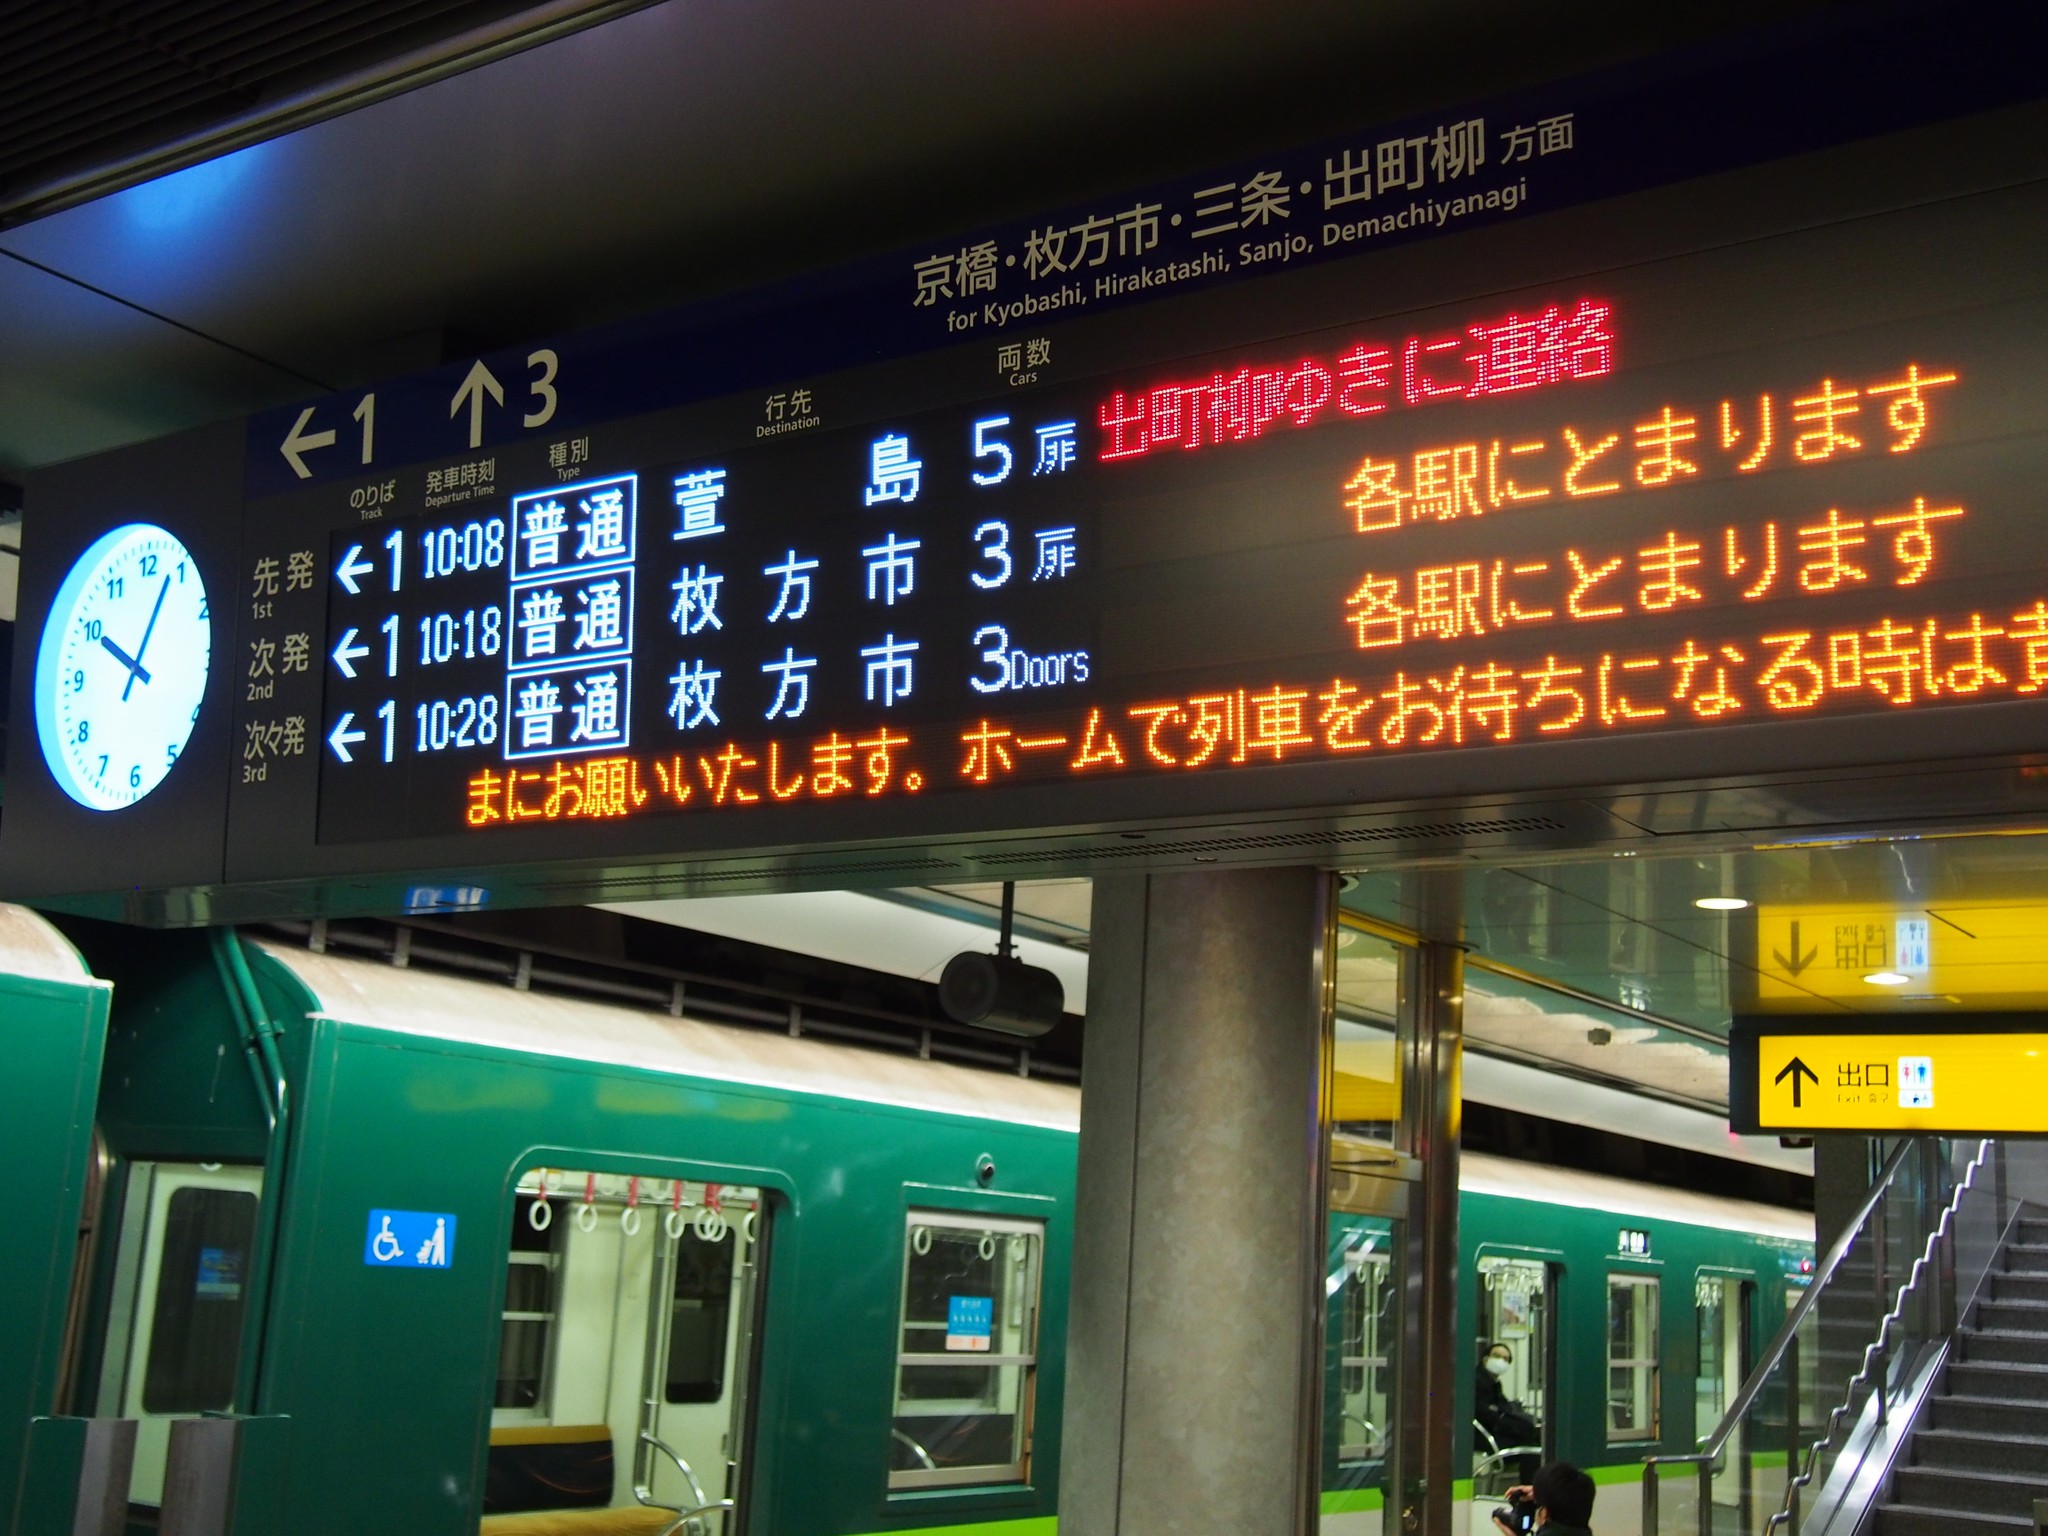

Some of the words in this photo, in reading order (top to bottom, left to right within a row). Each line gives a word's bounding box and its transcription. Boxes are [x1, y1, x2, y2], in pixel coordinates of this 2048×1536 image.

[1501, 113, 1574, 165] 方面
[947, 309, 977, 332] for
[984, 282, 1087, 326] Kyobashi,
[1095, 248, 1231, 298] Hirakatashi,
[1239, 233, 1314, 266] Sanjo,
[1323, 177, 1527, 246] Demachiyanagi
[997, 337, 1052, 374] 両数
[524, 349, 558, 428] 3
[1009, 371, 1038, 387] Cars
[1101, 301, 1615, 459] 出町柳ゆきに連絡
[765, 388, 812, 421] 行先
[353, 394, 375, 464] 1
[756, 414, 820, 438] Destination
[549, 436, 589, 468] 種別
[1344, 365, 1957, 532] 各駅にとまります
[426, 458, 495, 495] 発車時刻
[558, 467, 580, 481] Type
[350, 479, 396, 509] のりば
[425, 488, 471, 507] Departure
[473, 484, 495, 498] Time
[360, 506, 383, 521] Track
[521, 487, 626, 567] 普通
[139, 555, 158, 578] 12
[386, 530, 402, 592] 1
[423, 519, 504, 579] 10:08
[106, 577, 124, 600] 11
[176, 561, 186, 584] 1
[252, 550, 314, 598] 先発
[1345, 497, 1964, 648] 各駅にとまります
[251, 602, 273, 620] 1st
[518, 580, 623, 657] 普通
[83, 619, 102, 643] 10
[382, 614, 399, 677] 1
[420, 606, 501, 665] 10:18
[248, 633, 310, 680] 次発
[73, 670, 85, 693] 9
[247, 682, 274, 701] 2nd
[515, 671, 620, 747] 普通
[77, 720, 89, 743] 8
[243, 715, 305, 761] 次々発
[379, 700, 395, 763] 1
[417, 694, 498, 752] 10:28
[98, 754, 110, 778] 7
[166, 744, 178, 768] 5
[129, 764, 141, 788] 6
[242, 762, 267, 784] 3rd
[1838, 1062, 1889, 1087] 出口
